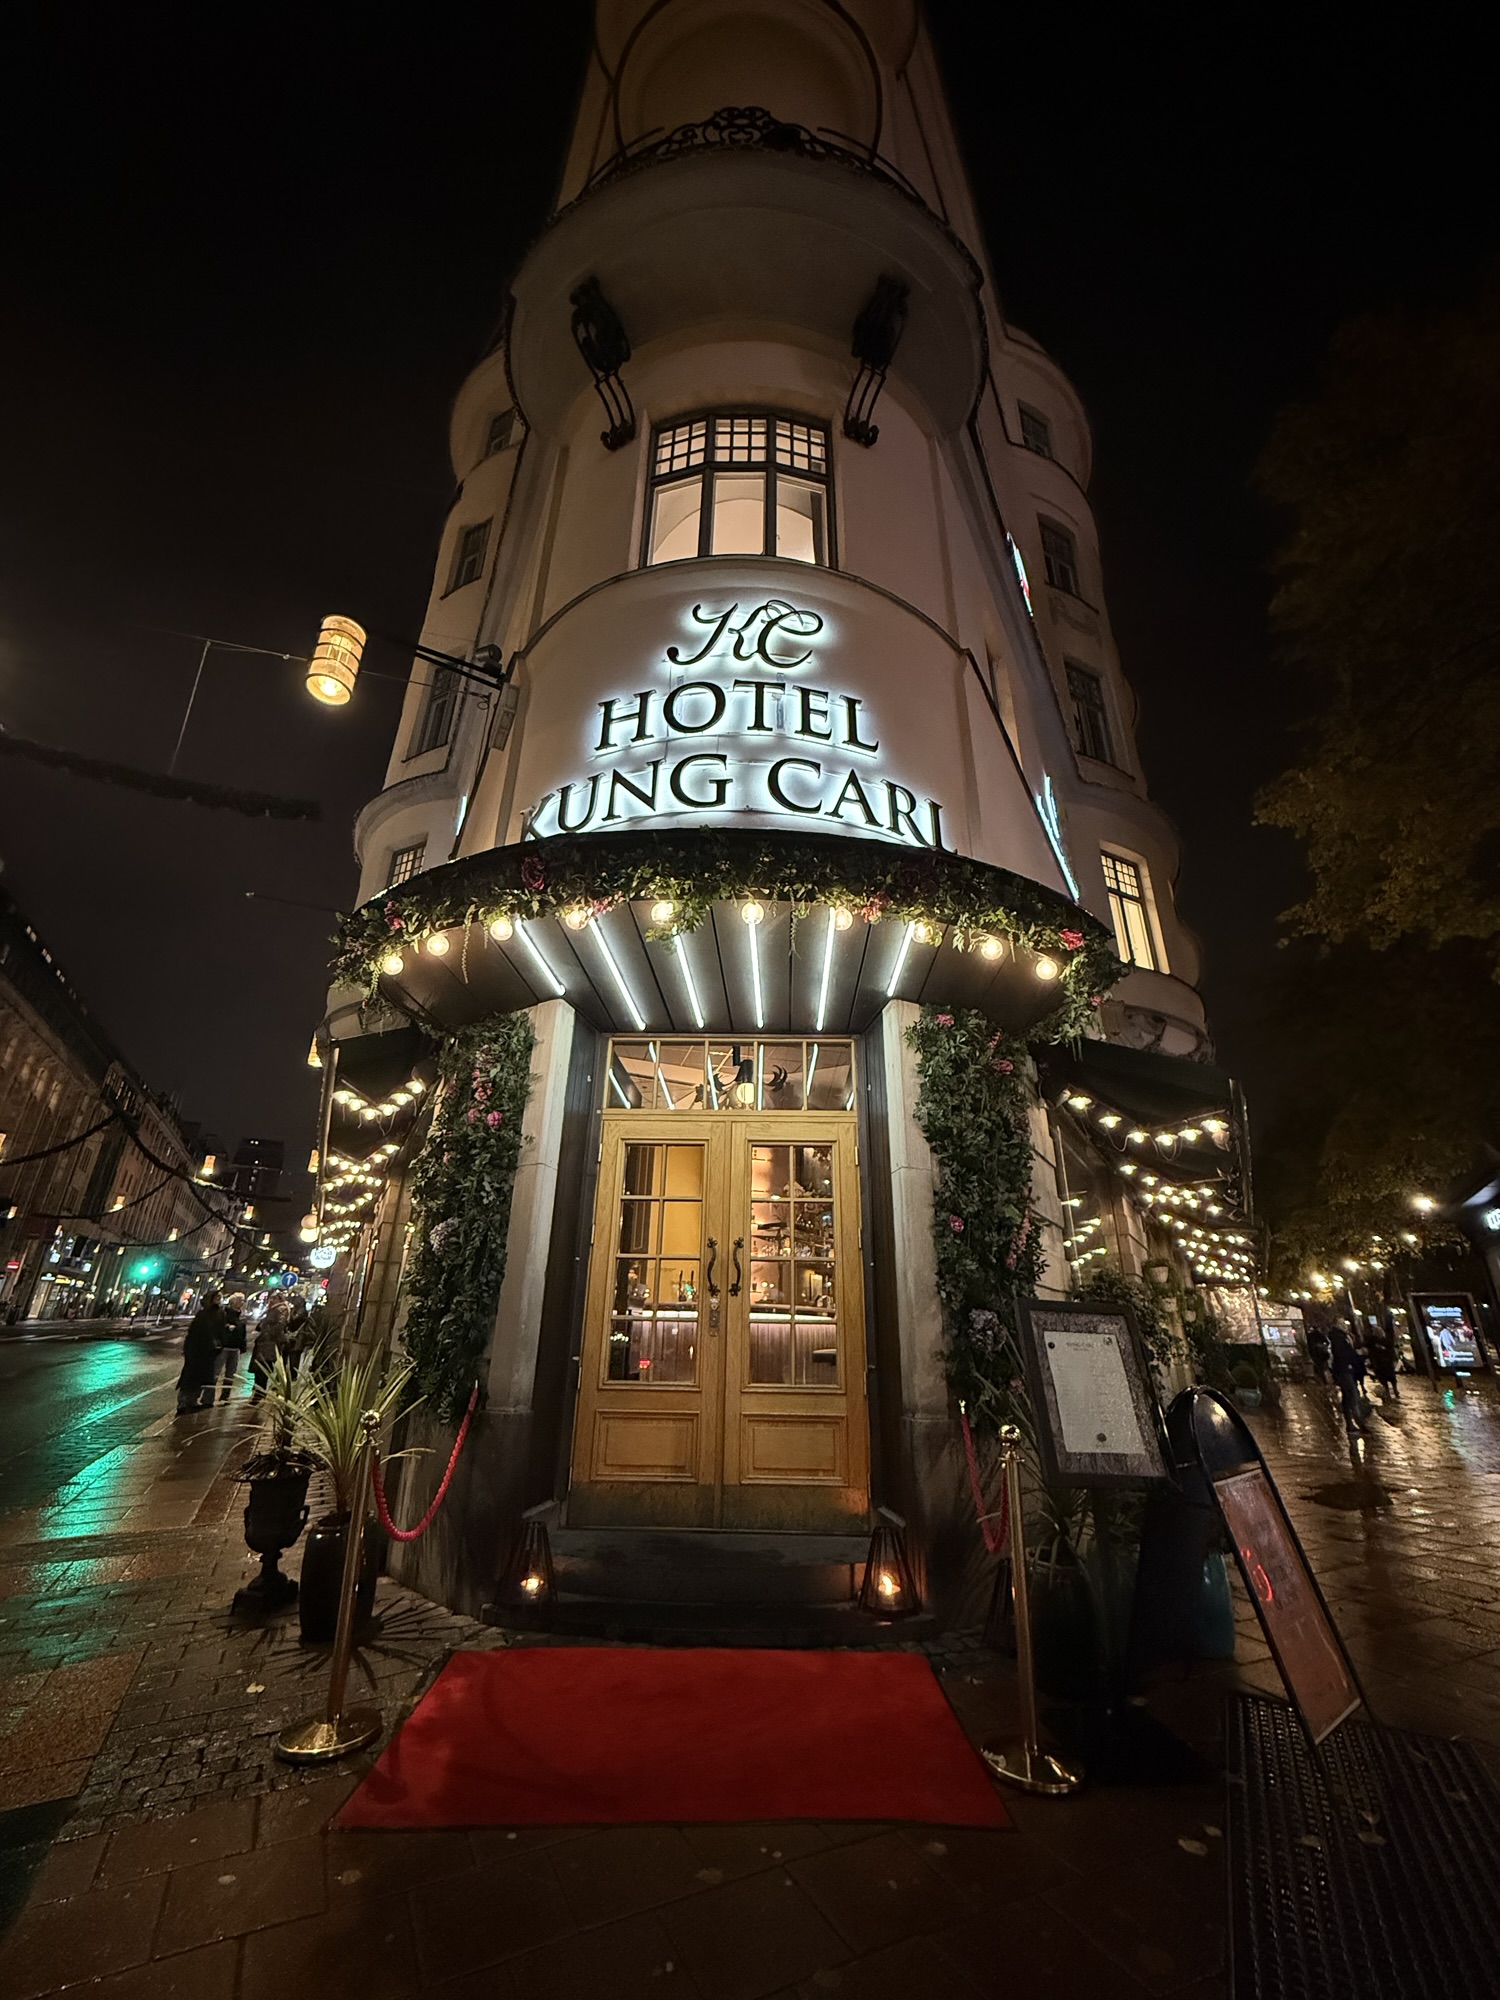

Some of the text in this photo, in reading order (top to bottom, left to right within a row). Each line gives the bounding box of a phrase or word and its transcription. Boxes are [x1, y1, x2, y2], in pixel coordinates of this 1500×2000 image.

[666, 599, 823, 669] KC
[594, 679, 880, 752] HOTEL
[519, 753, 734, 839] KUNG
[767, 757, 958, 855] CARL
